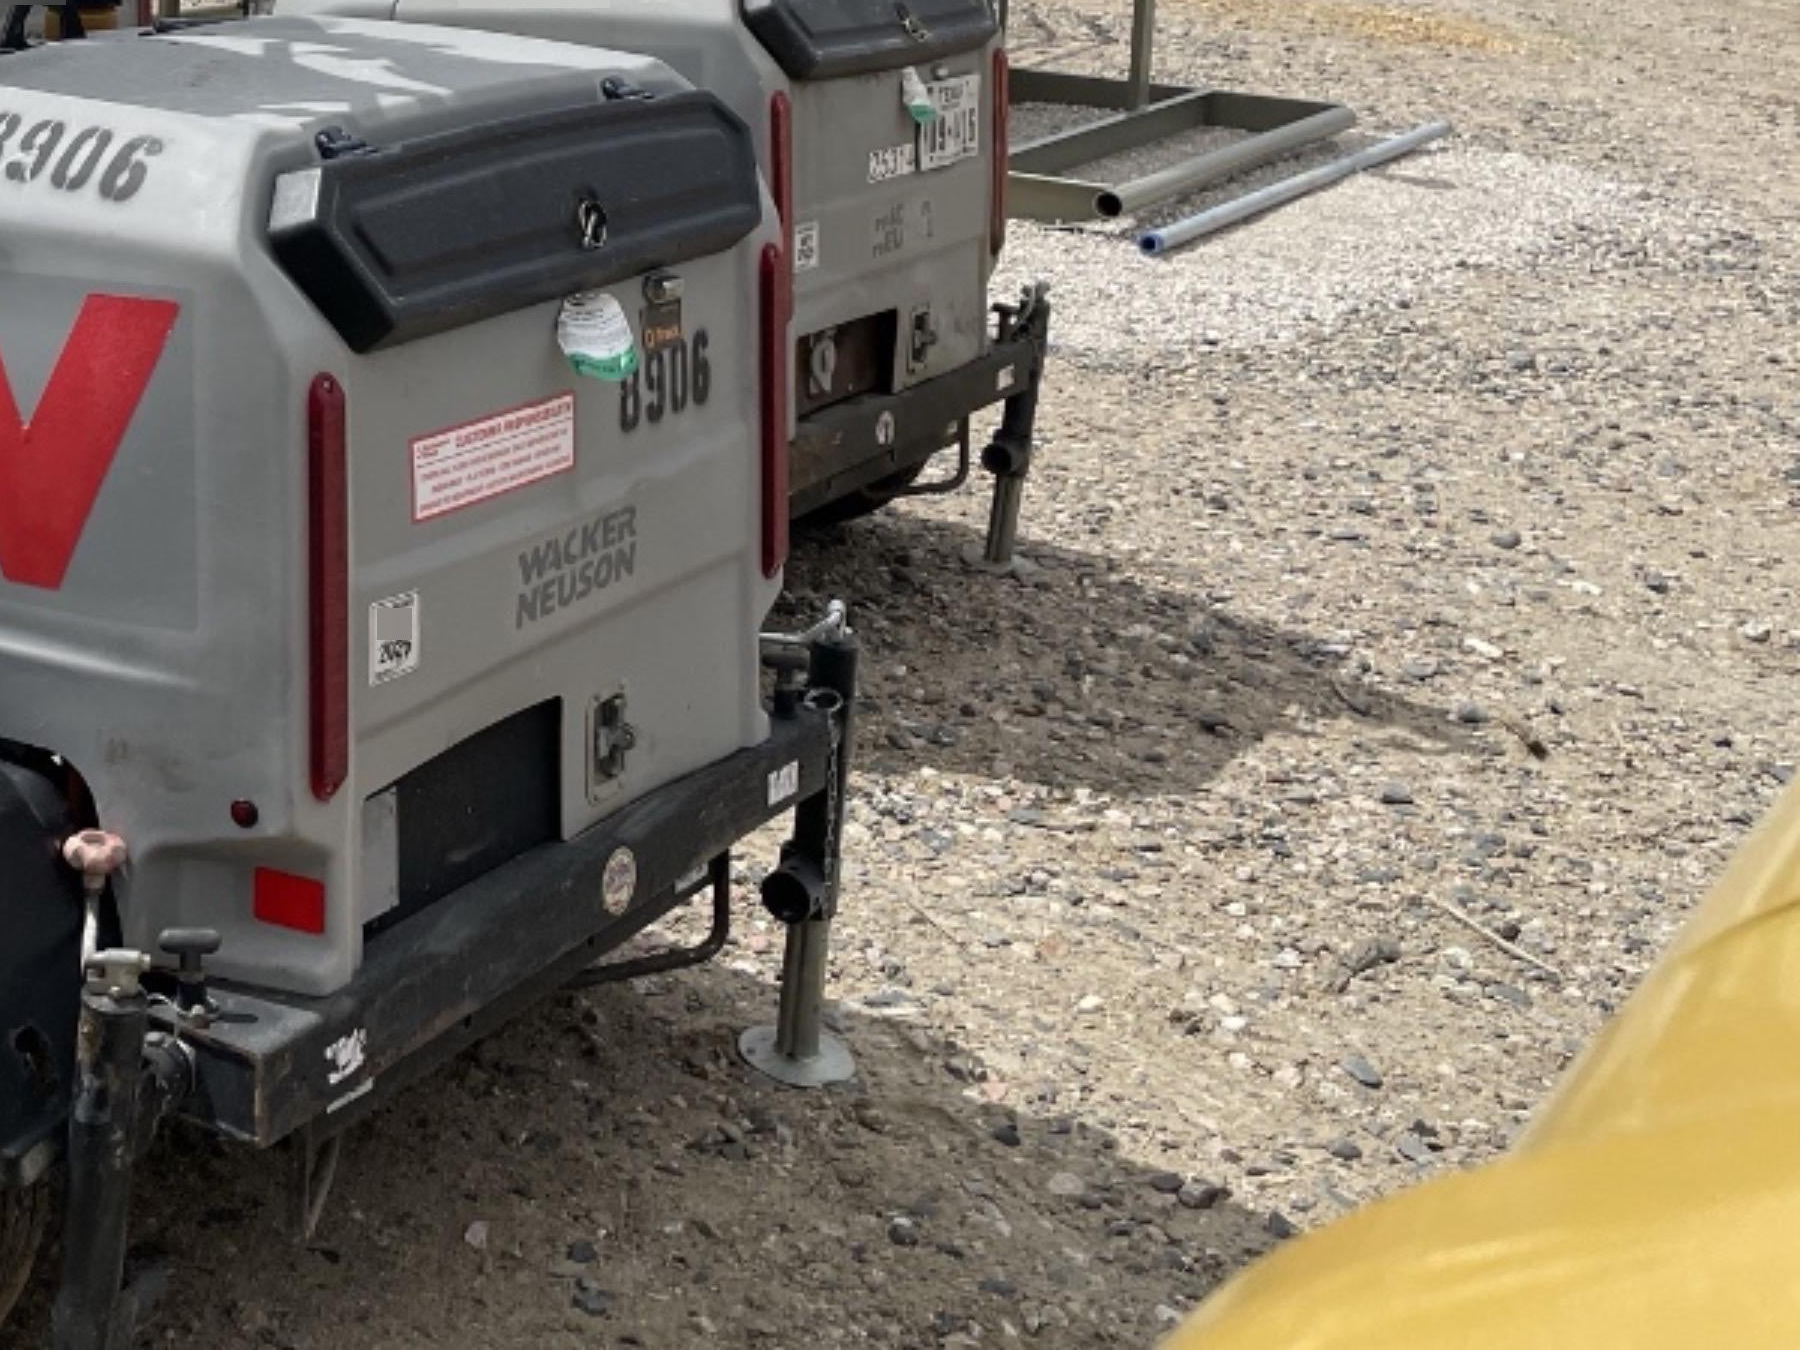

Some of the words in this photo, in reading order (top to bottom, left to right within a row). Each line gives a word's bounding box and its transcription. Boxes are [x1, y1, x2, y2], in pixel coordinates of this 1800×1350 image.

[619, 328, 710, 433] 8906
[516, 540, 637, 631] NEUSON
[518, 505, 637, 586] WACKER
